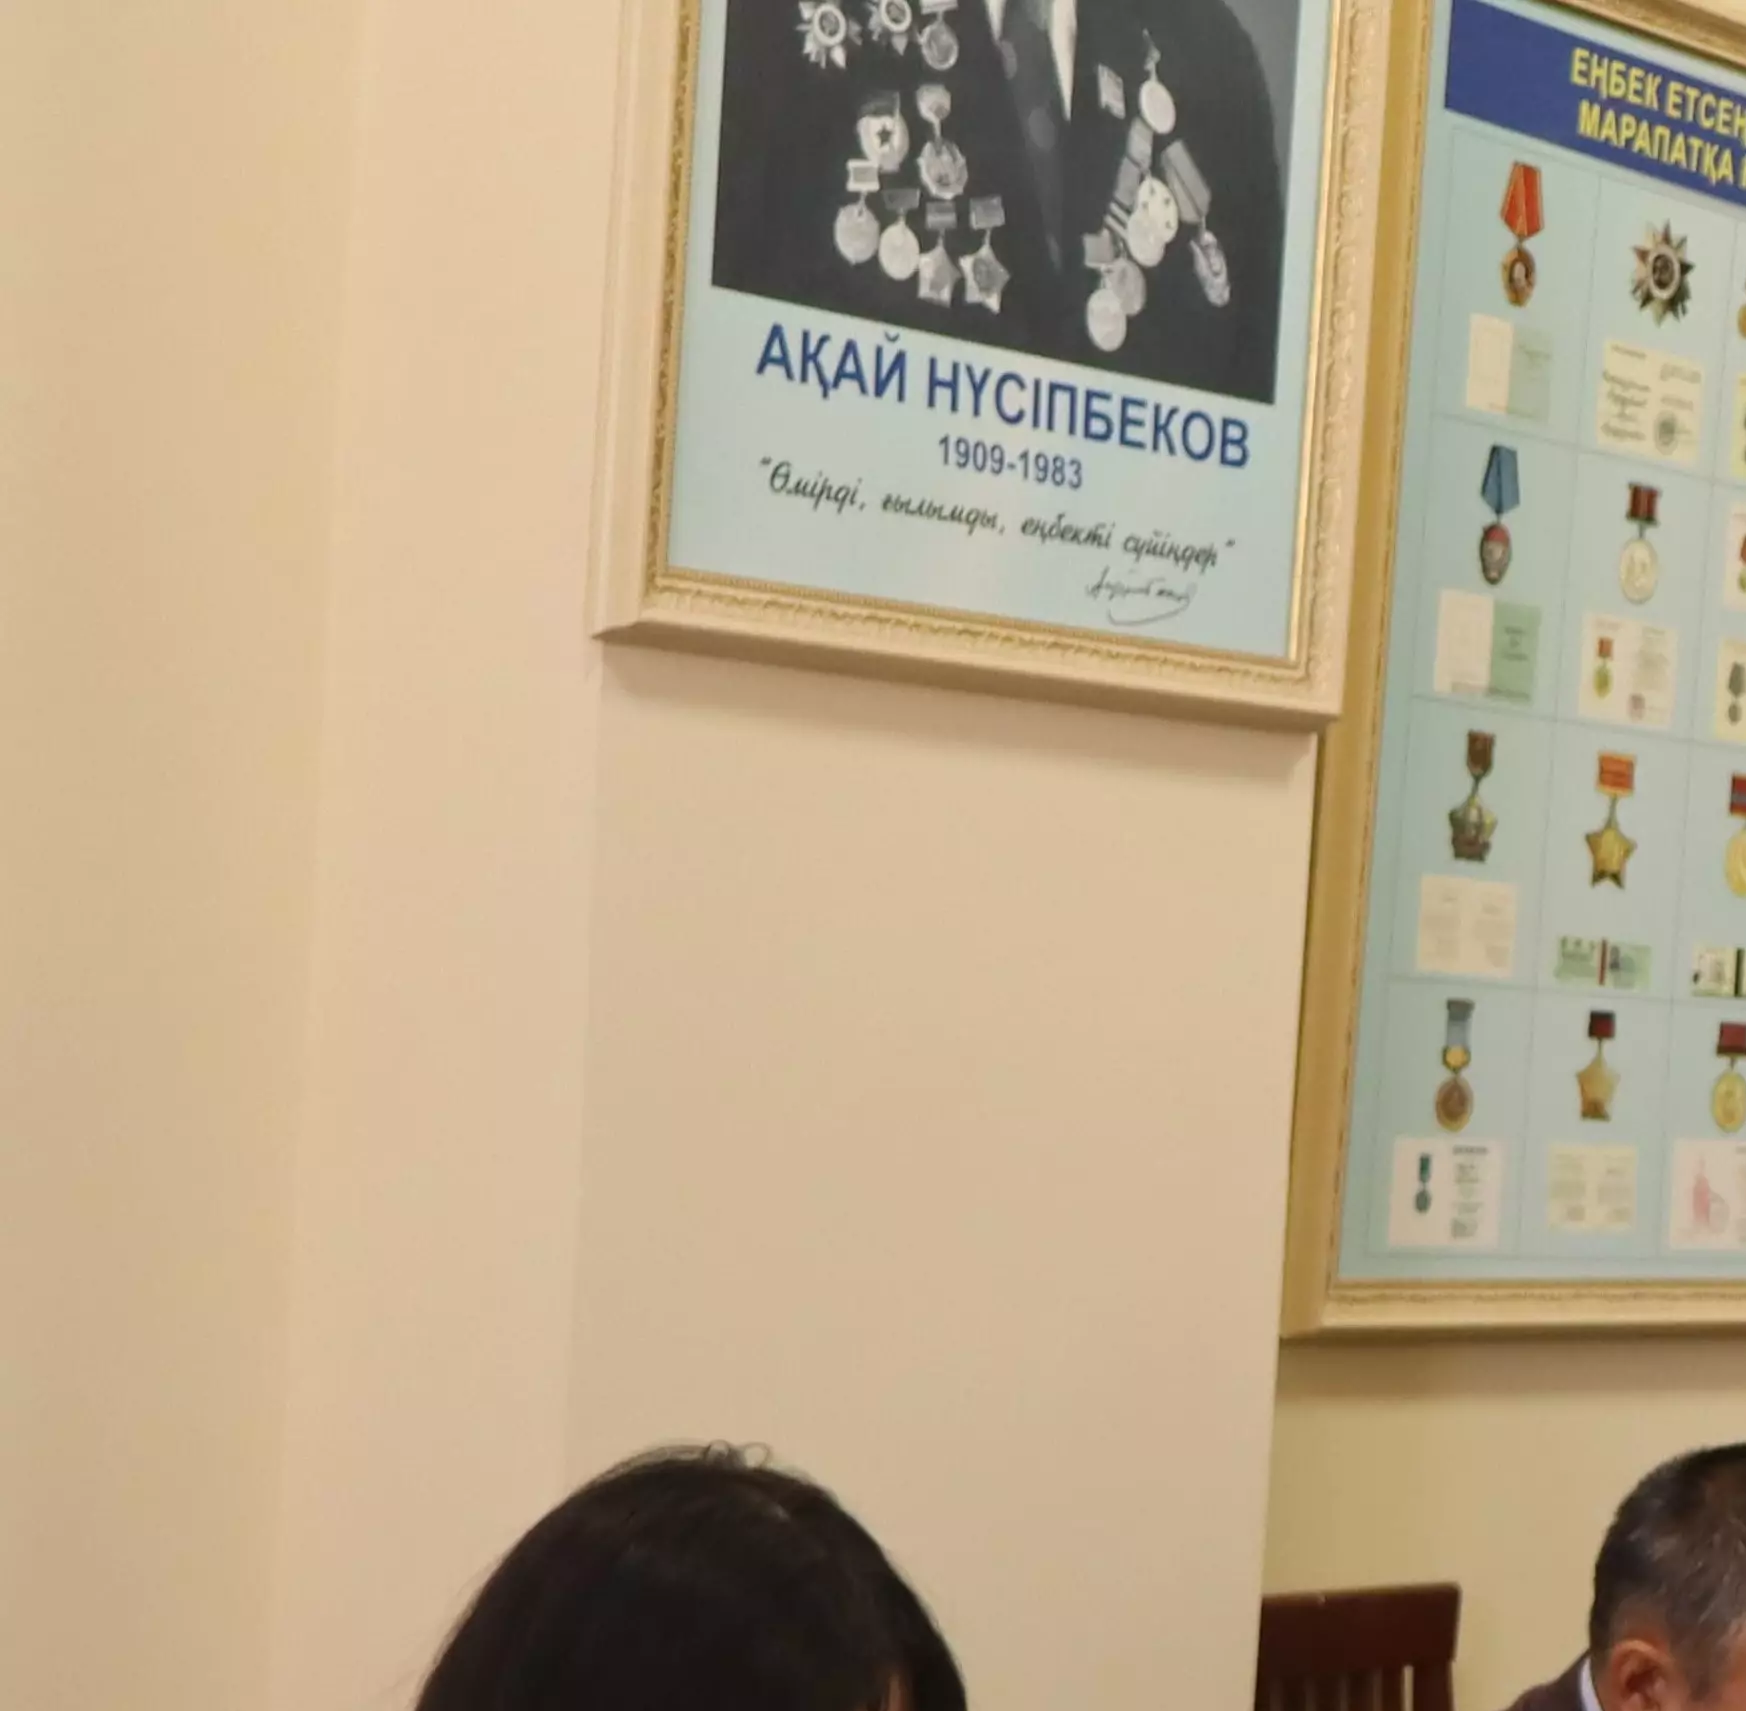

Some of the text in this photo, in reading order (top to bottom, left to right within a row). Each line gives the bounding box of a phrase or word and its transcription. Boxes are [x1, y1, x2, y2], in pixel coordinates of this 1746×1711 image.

[1570, 46, 1661, 101] ЕҢБЕК
[1577, 99, 1735, 190] МАРАПАТҚА
[755, 322, 1252, 469] АҚАЙ НҮСІПБЕКОВ
[937, 435, 1084, 492] 1909-1983
